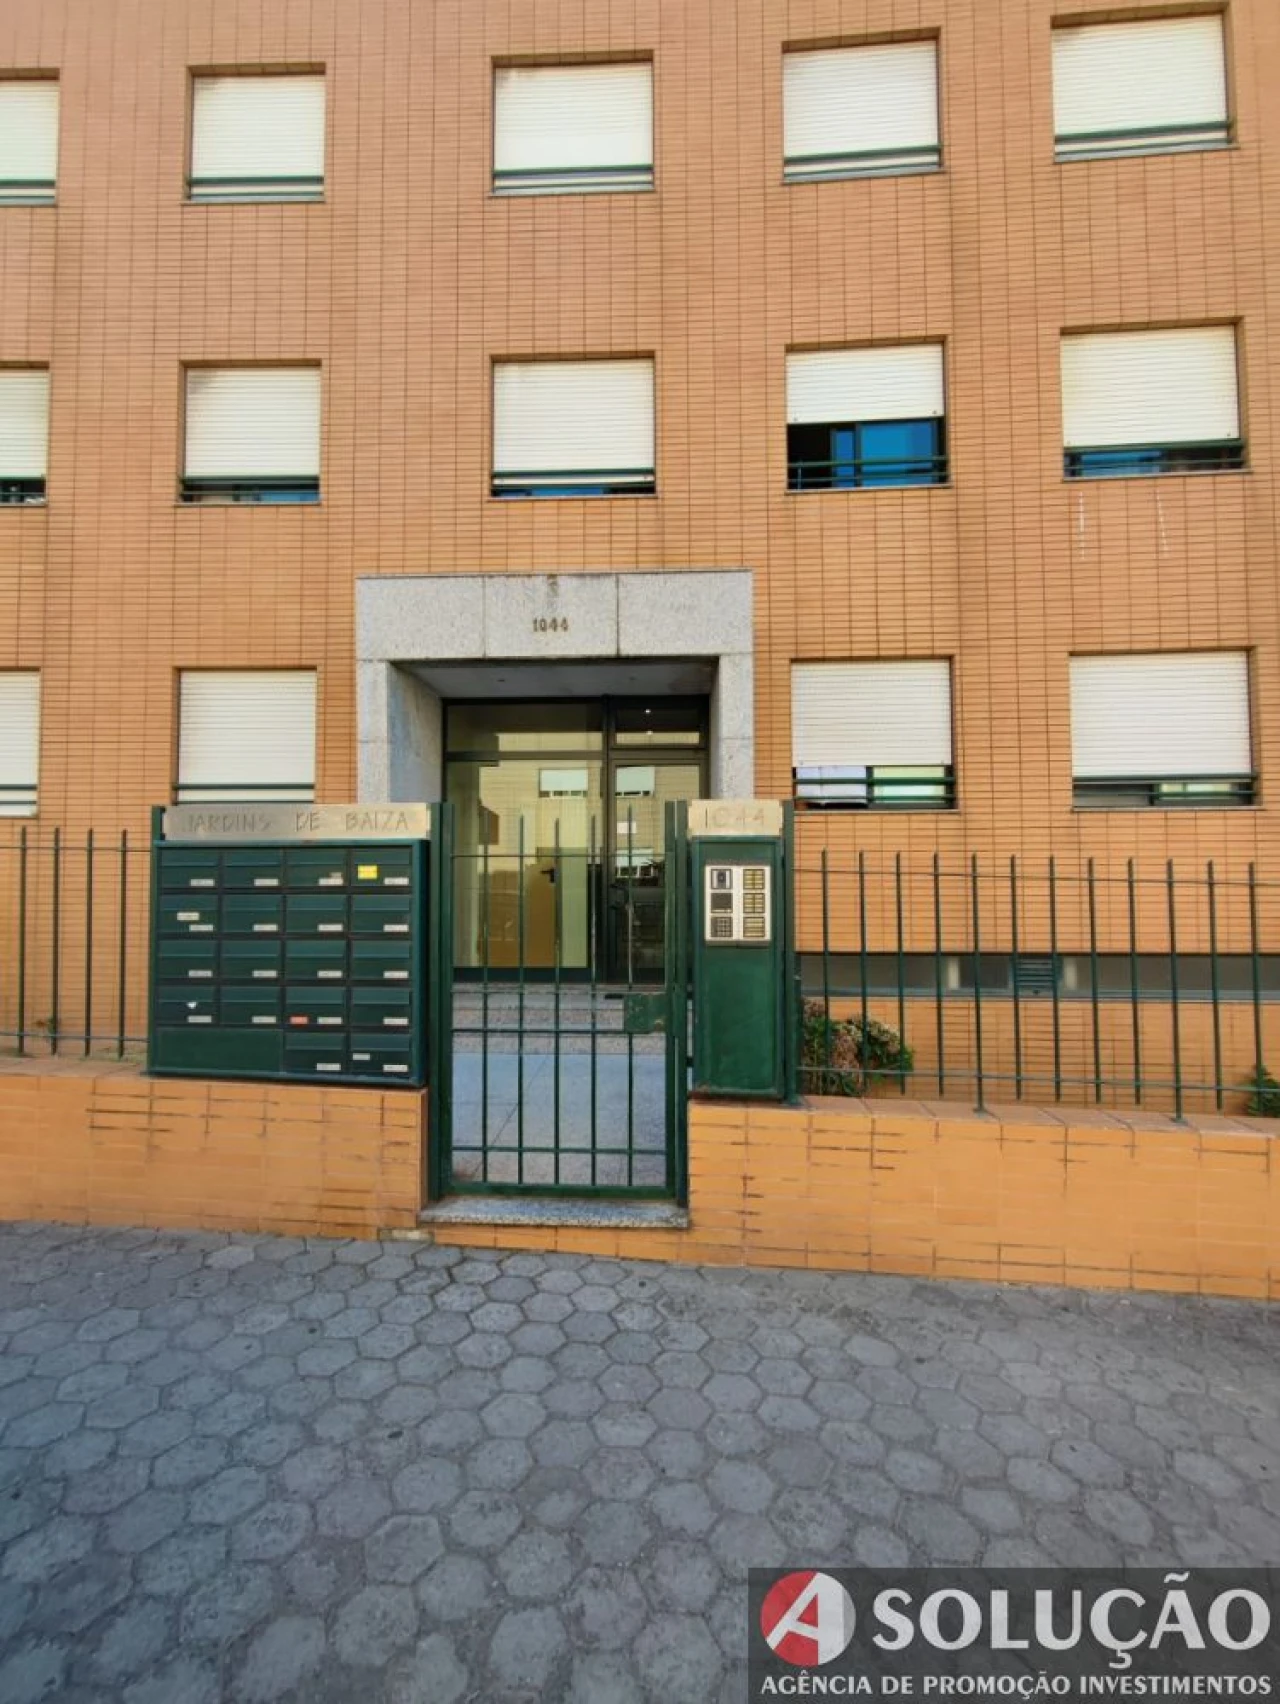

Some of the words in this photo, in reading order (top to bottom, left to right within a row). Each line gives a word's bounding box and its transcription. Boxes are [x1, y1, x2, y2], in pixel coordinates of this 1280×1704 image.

[533, 617, 569, 633] 1044
[295, 811, 321, 832] DE
[345, 810, 409, 832] BAIZA
[705, 806, 764, 828] 1044
